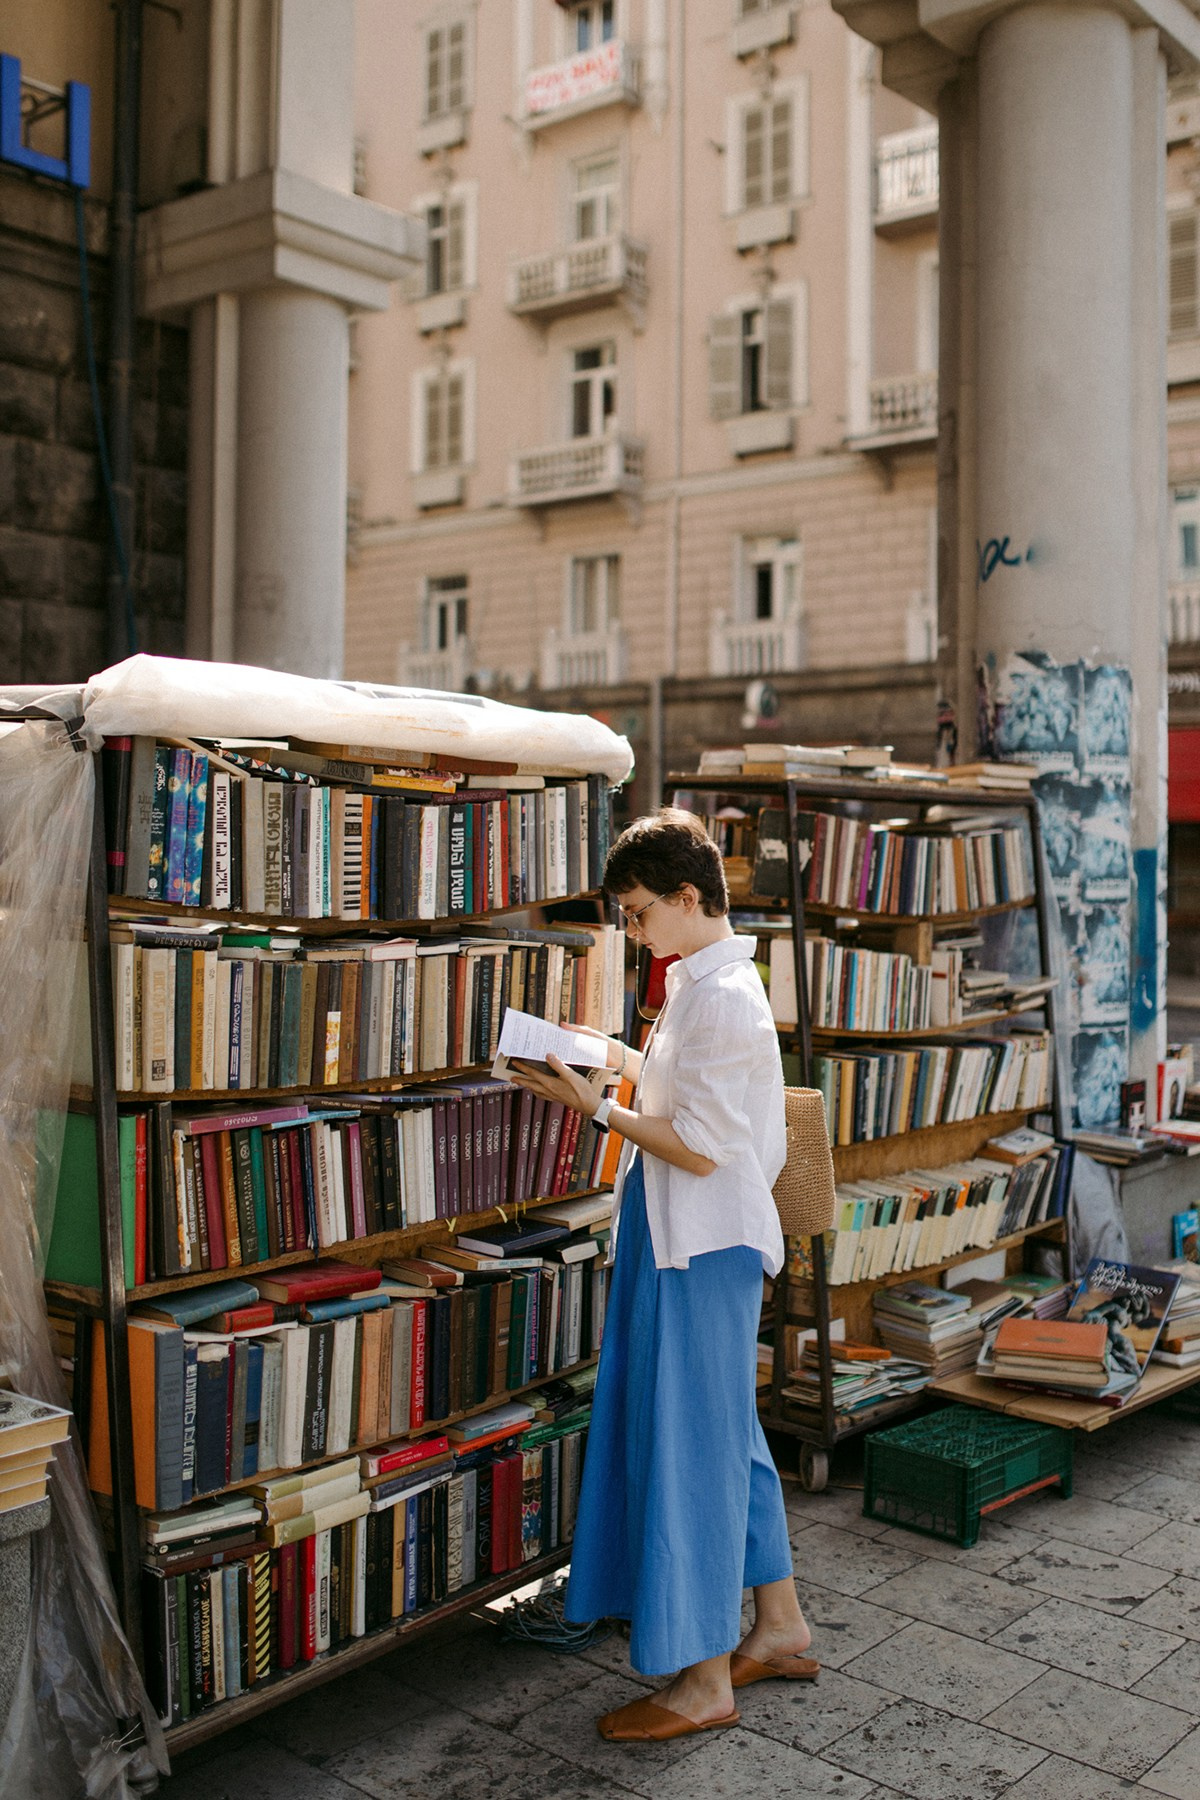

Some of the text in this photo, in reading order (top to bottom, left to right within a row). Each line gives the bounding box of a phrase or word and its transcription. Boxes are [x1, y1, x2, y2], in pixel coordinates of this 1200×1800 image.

[451, 827, 464, 867] დიკი
[451, 868, 464, 910] მობი
[193, 1597, 202, 1686] ЗАКОНЫ ВАХТАНГА VI
[201, 1598, 210, 1667] НЕЗАБЫВАЕМОЕ
